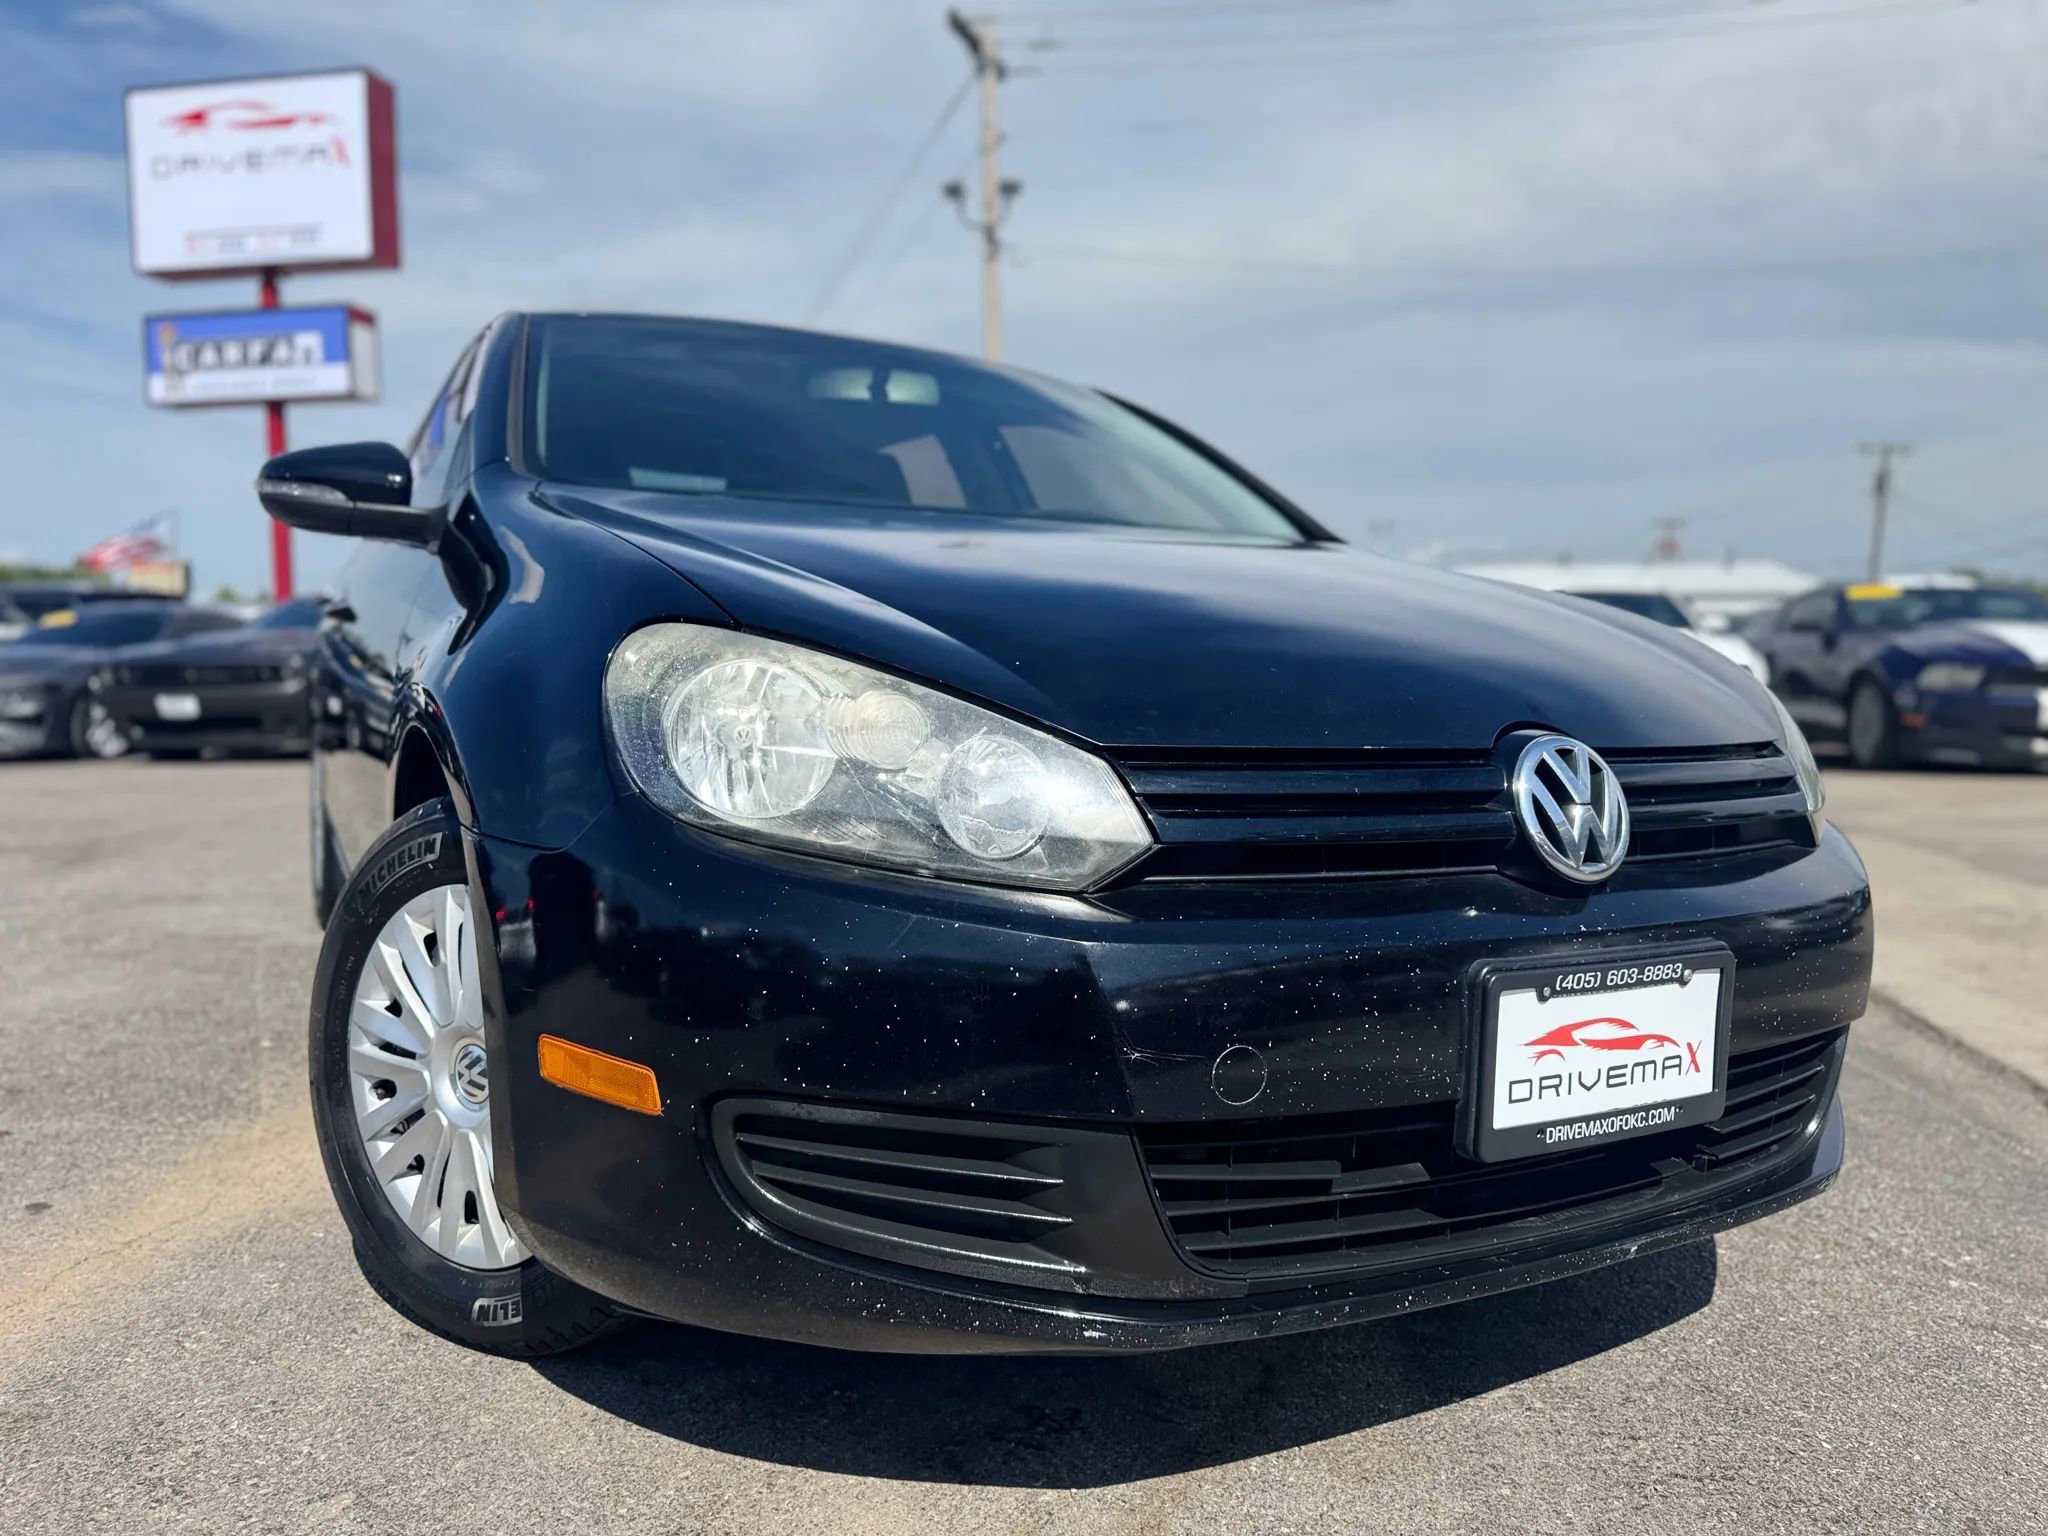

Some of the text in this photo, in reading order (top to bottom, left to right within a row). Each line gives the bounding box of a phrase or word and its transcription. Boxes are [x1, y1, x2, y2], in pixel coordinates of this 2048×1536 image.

[357, 837, 438, 897] MICHELIN
[1555, 963, 1683, 991] (405) 603-8883
[1508, 1040, 1702, 1105] DRIVEMAX
[1546, 1106, 1675, 1144] DRIVEMAXOFOKC.COM
